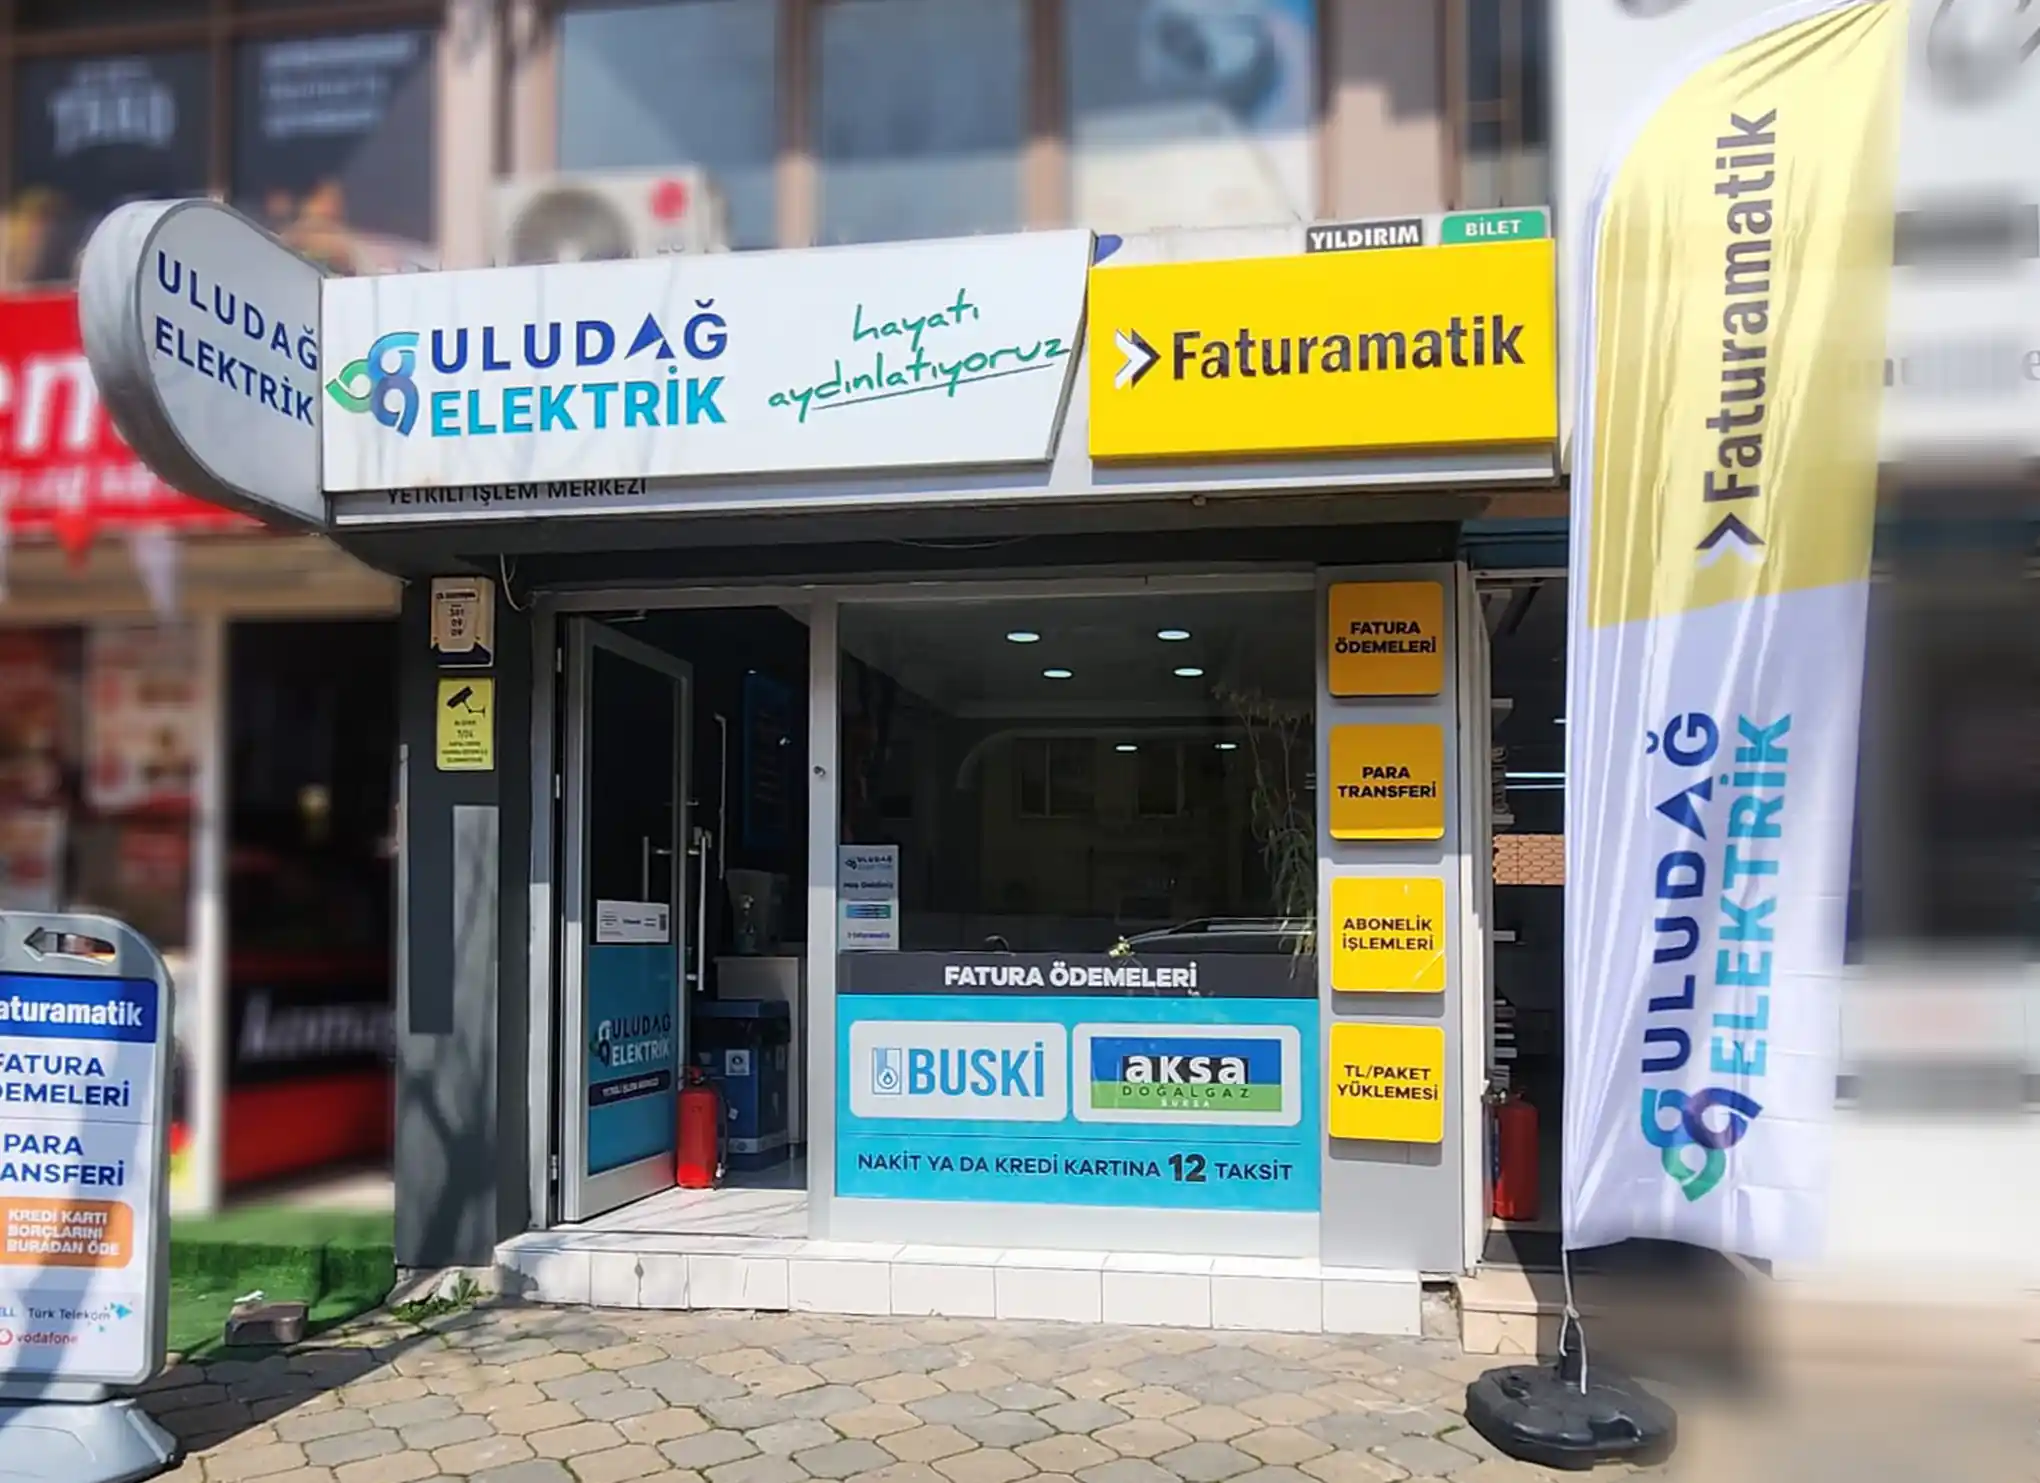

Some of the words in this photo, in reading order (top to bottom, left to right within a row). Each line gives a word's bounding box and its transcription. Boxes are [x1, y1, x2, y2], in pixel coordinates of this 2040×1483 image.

[1310, 224, 1420, 250] YILDIRIM
[1465, 217, 1522, 237] BİLET
[158, 249, 318, 371] ULUDAĞ
[1702, 108, 1777, 502] Faturamatik
[853, 287, 979, 352] hayatı
[431, 298, 728, 374] ULUDAĞ
[1172, 315, 1525, 381] Faturamatik
[155, 314, 315, 427] ELEKTRİK
[767, 337, 1072, 423] aydınlatıyoruz
[430, 365, 728, 438] ELEKTRİK
[1350, 621, 1421, 635] FATURA
[1335, 636, 1437, 654] ÖDEMELERİ
[1362, 766, 1411, 779] PARA
[1337, 781, 1437, 798] TRANSFERİ
[1641, 711, 1720, 1073] ULUDAĞ
[1710, 713, 1792, 1077] ELEKTRİK
[1343, 915, 1433, 931] ABONELİK
[1342, 933, 1434, 951] İŞLEMLERİ
[945, 966, 1044, 986] FATURA
[1050, 961, 1198, 988] ÖDEMELERİ
[908, 1041, 1044, 1097] BUSKİ
[1125, 1055, 1246, 1084] aksa
[1344, 1064, 1431, 1080] TL/PAKET
[0, 1080, 130, 1107] EMELERİ
[1122, 1085, 1250, 1098] DOĞALGAZ
[1337, 1081, 1438, 1101] YÜKLEMESİ
[4, 1133, 84, 1156] PARA
[858, 1150, 921, 1172] NAKİT
[928, 1156, 953, 1171] YA
[960, 1157, 988, 1172] DA
[995, 1153, 1058, 1175] KREDİ
[1064, 1159, 1161, 1178] KARTINA
[1168, 1154, 1206, 1182] 12
[1215, 1158, 1292, 1181] TAKSİT
[8, 1209, 57, 1222] KREDİ
[62, 1211, 107, 1225] KARTI
[8, 1223, 103, 1240] BORÇLARINI
[7, 1239, 82, 1254] BURADAN
[88, 1238, 120, 1256] ÖDE
